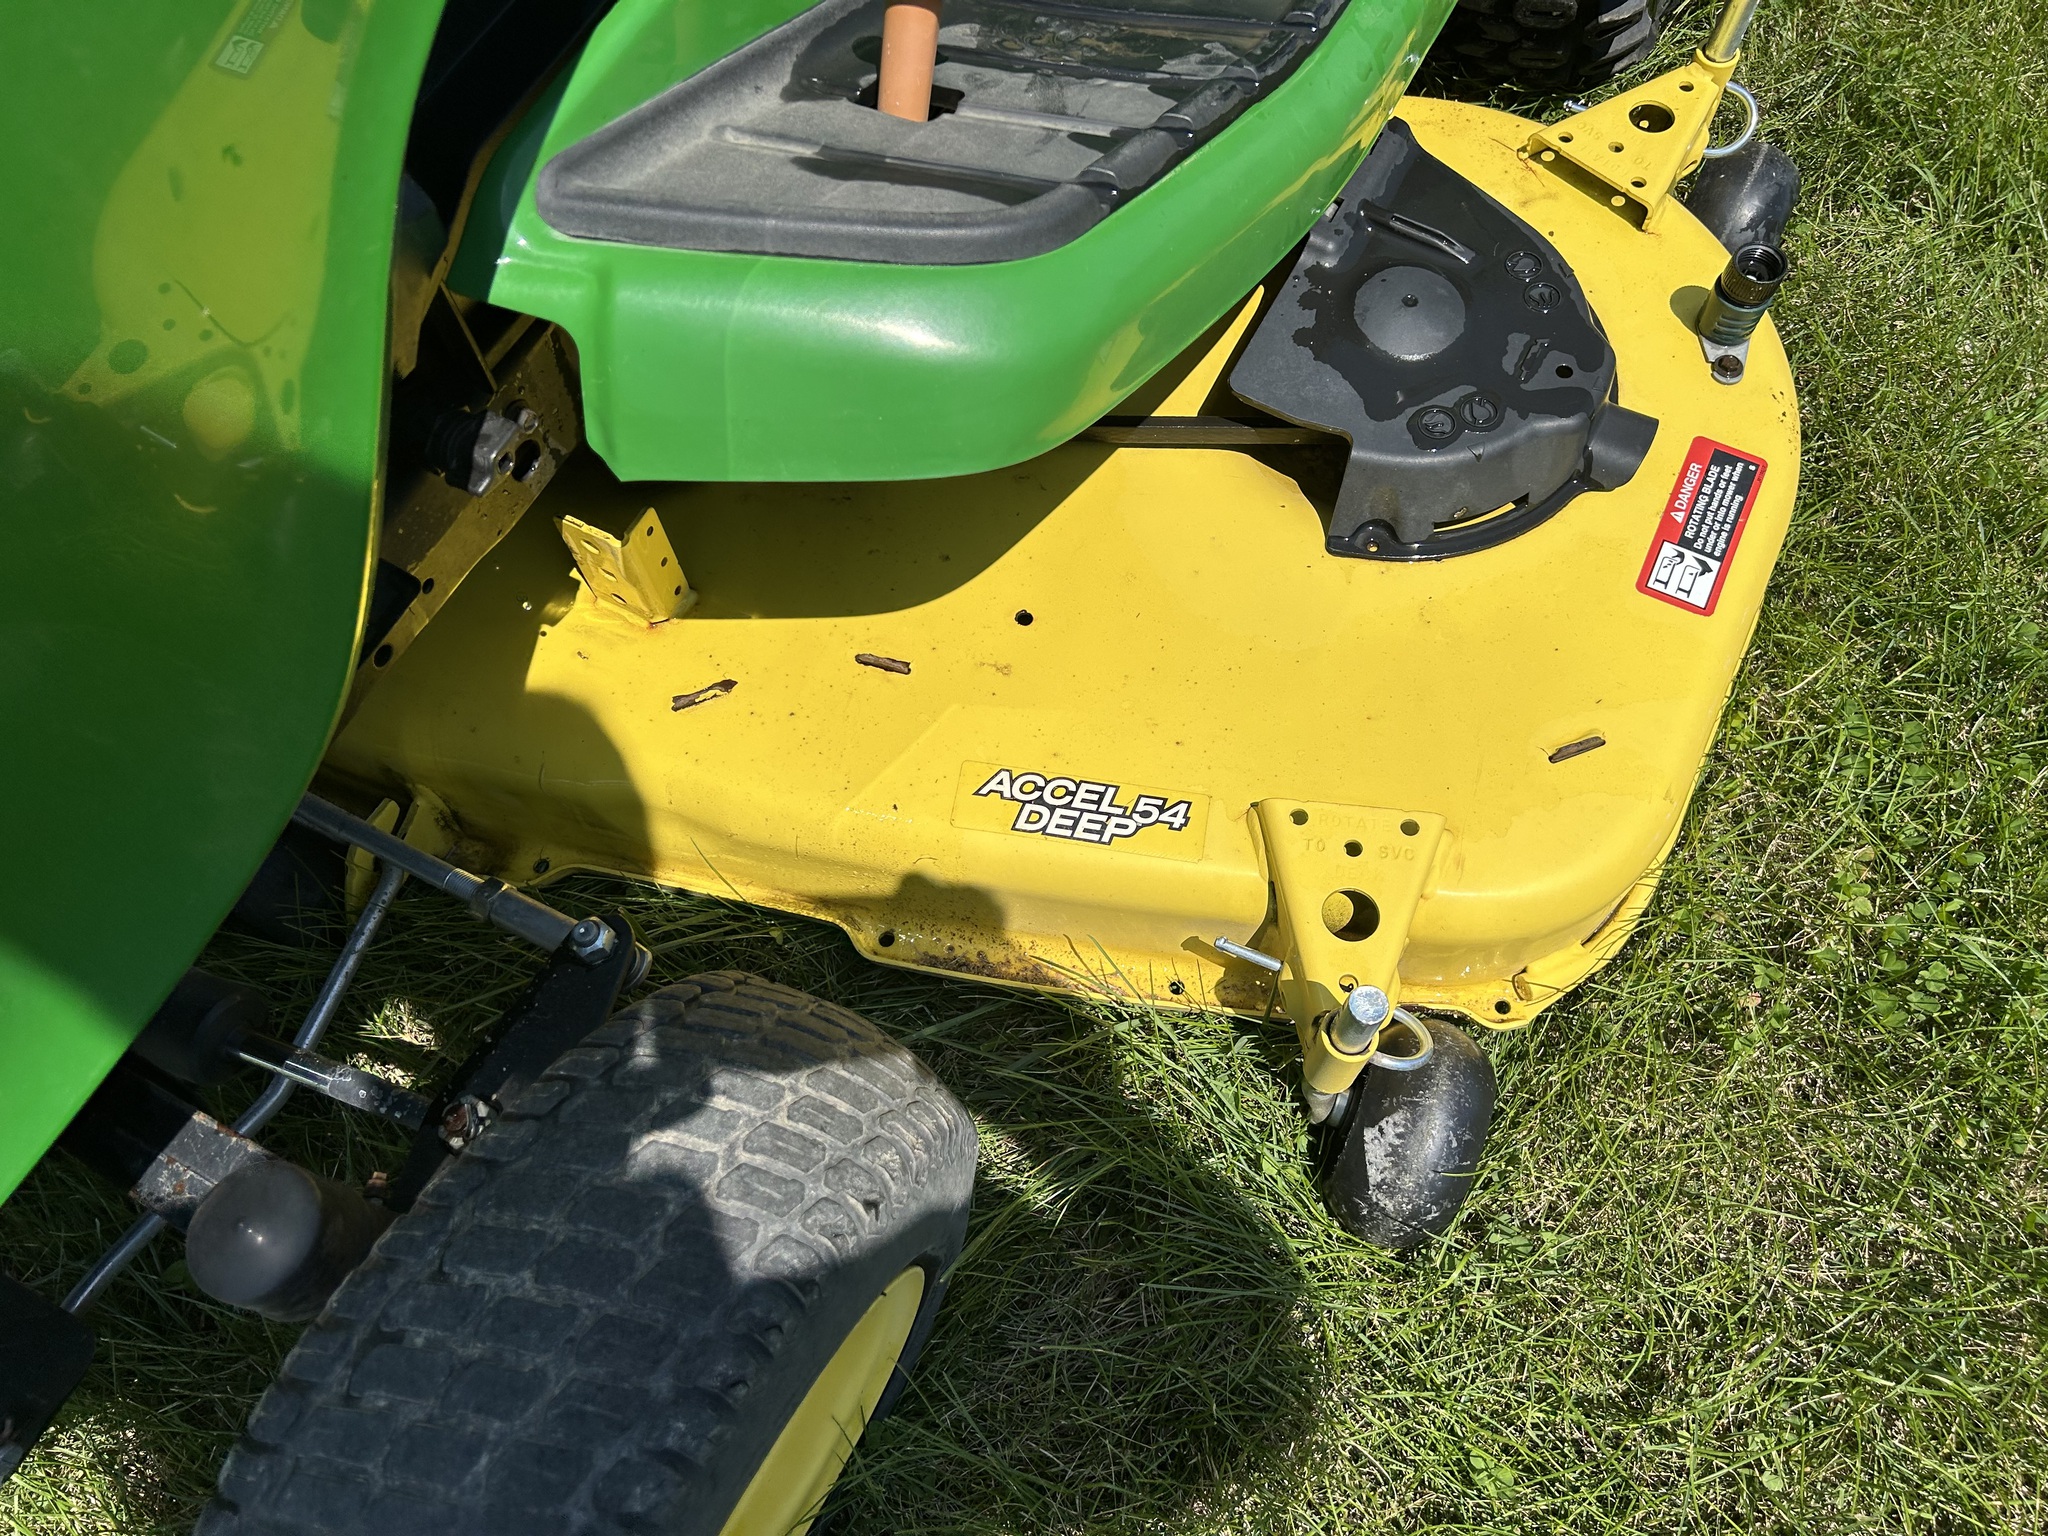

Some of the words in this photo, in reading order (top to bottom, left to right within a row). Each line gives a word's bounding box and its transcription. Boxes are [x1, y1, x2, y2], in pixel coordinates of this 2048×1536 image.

[1720, 464, 1733, 480] feet
[1731, 461, 1745, 482] when
[1674, 462, 1702, 511] DANGER
[1718, 479, 1727, 489] or
[1721, 481, 1736, 507] mower
[1684, 494, 1710, 539] ROTATING
[1701, 464, 1720, 495] BLADE
[1708, 488, 1724, 512] hands
[1725, 494, 1744, 523] running
[1704, 512, 1715, 526] put
[1714, 506, 1727, 522] into
[1699, 524, 1710, 538] not
[1712, 521, 1721, 531] or
[1721, 521, 1731, 532] is
[1693, 537, 1705, 550] Do
[1704, 530, 1718, 553] under
[1713, 530, 1729, 557] engine
[972, 768, 1128, 816] ACCEL
[1131, 794, 1192, 832] 54
[1011, 801, 1139, 846] DEEP
[1319, 813, 1393, 833] ROTATE
[1303, 837, 1326, 853] TO
[1378, 844, 1416, 862] SVC
